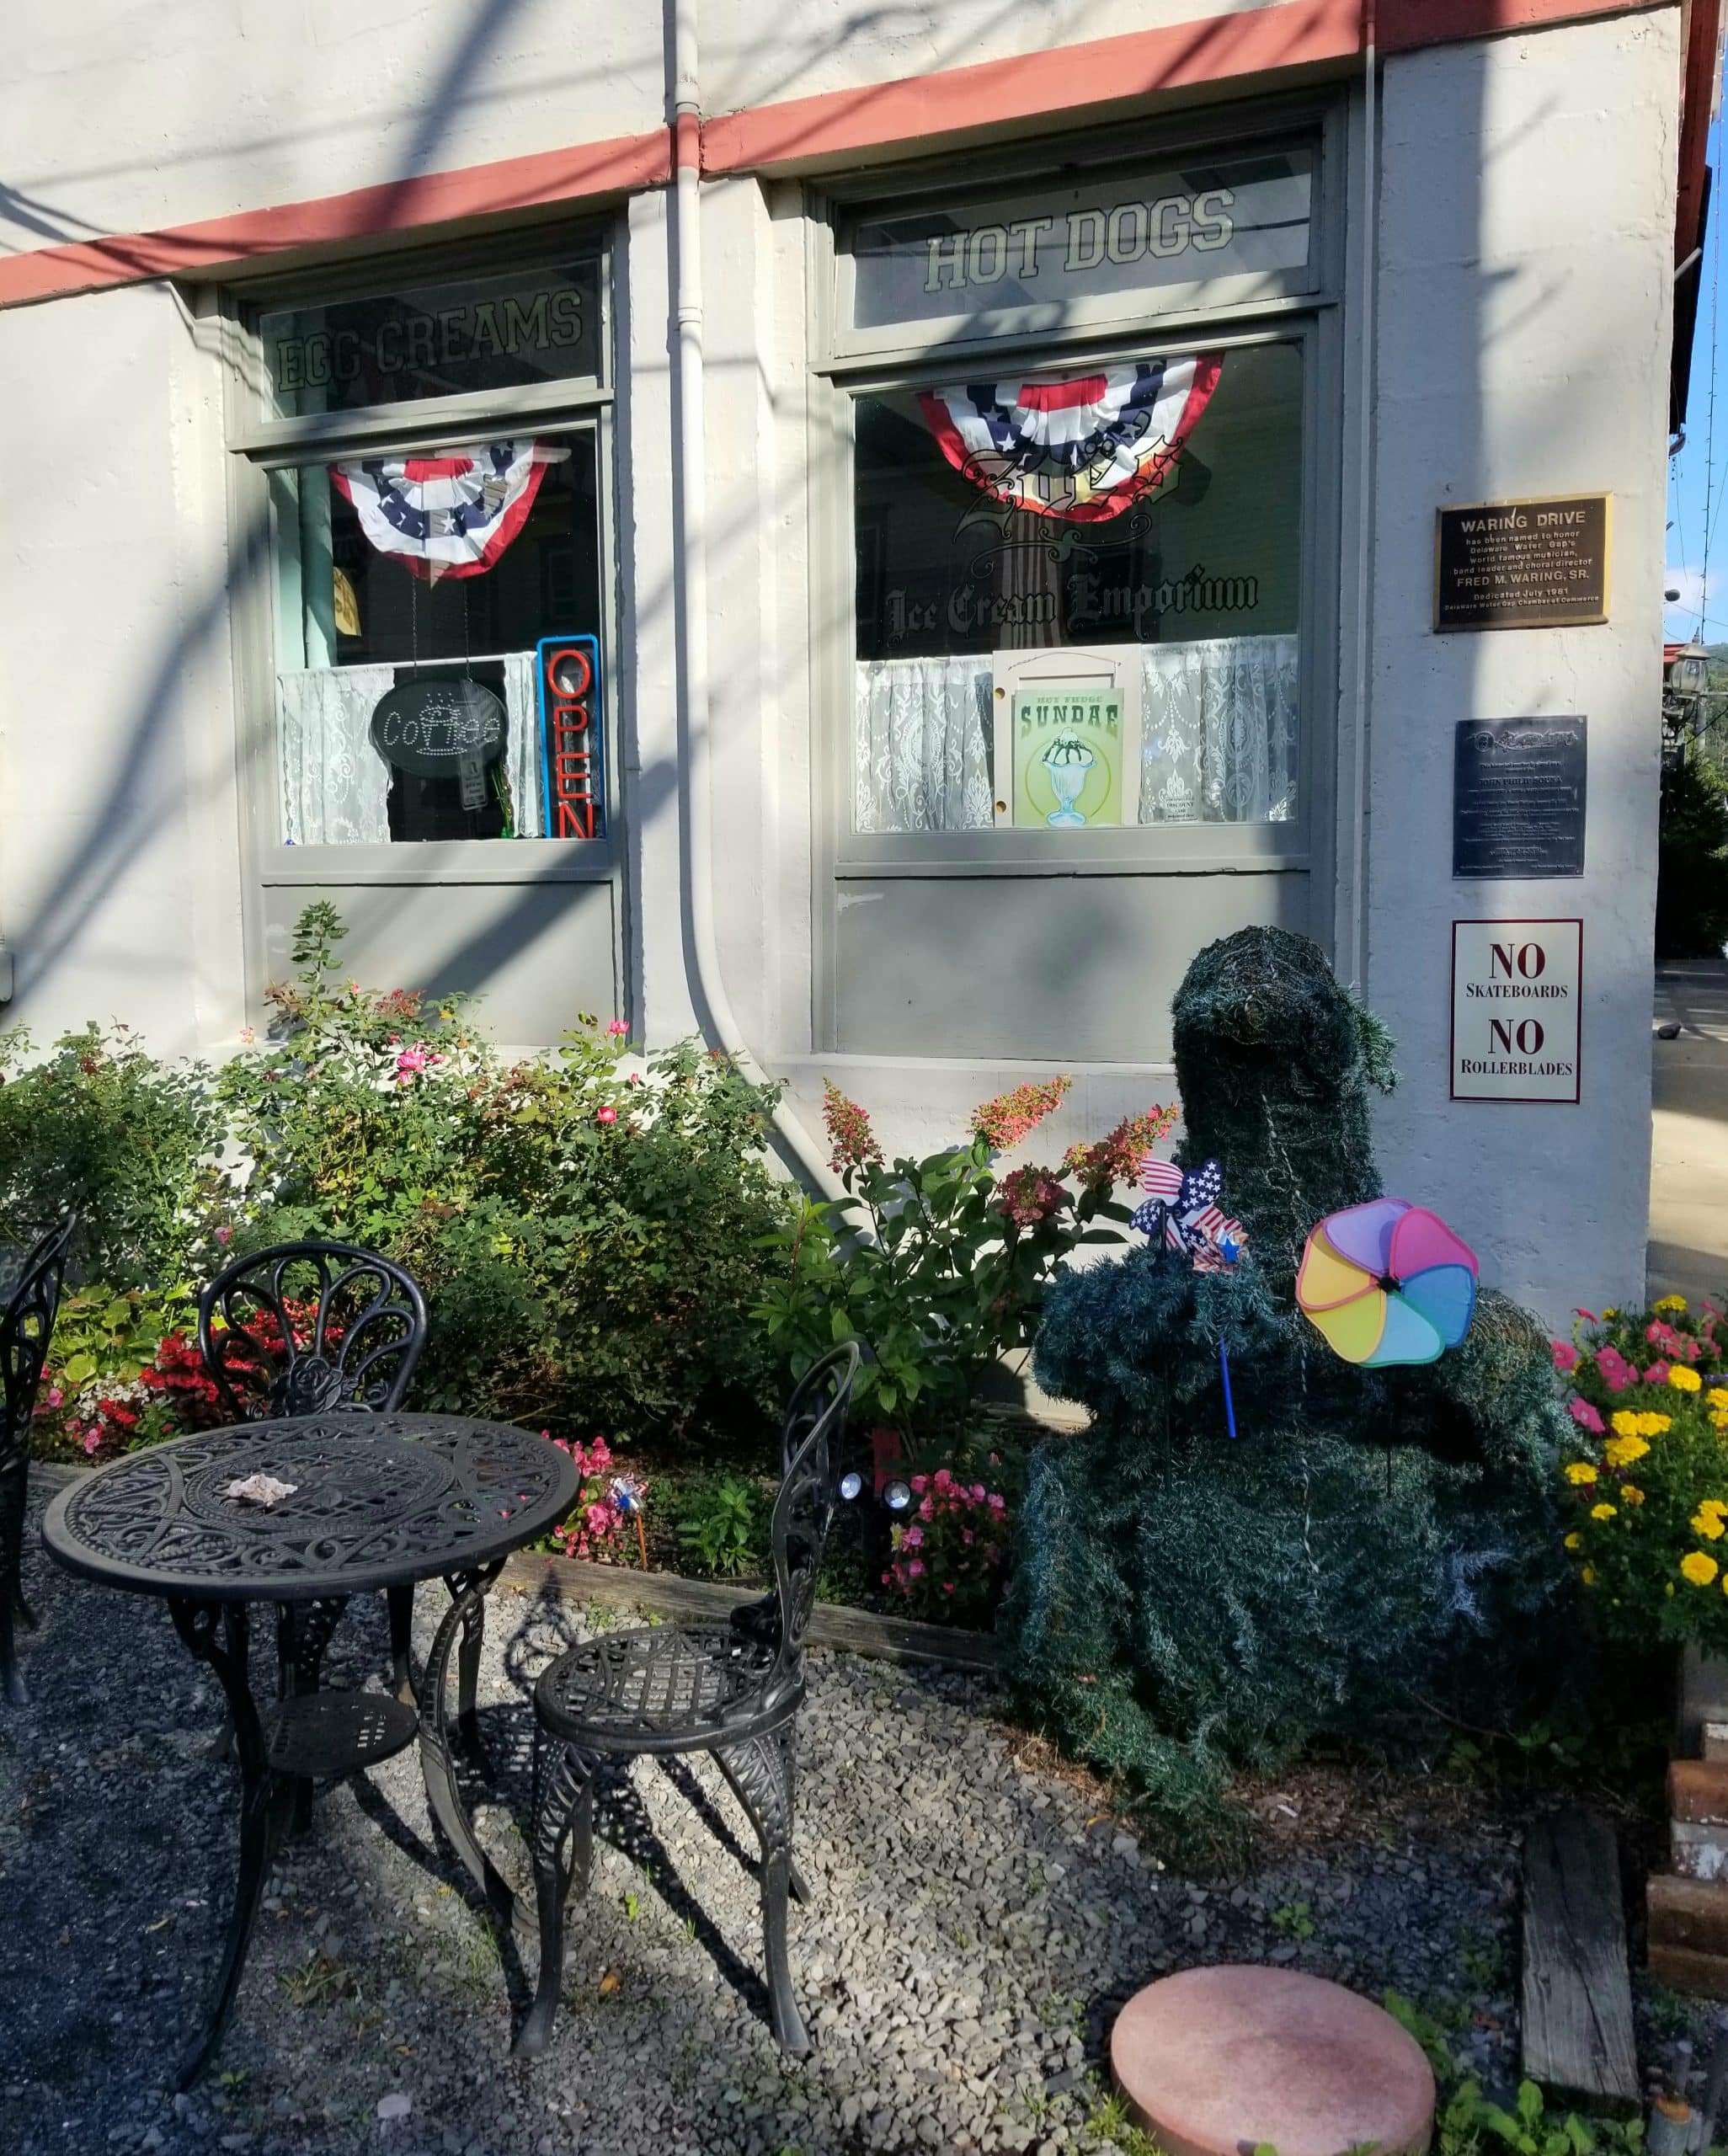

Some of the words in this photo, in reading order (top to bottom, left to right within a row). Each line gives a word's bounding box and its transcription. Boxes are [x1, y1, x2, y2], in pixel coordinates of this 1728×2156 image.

[924, 216, 1053, 293] HOT
[1064, 188, 1235, 272] DOGS
[276, 332, 361, 392] EGG
[376, 288, 583, 375] CREAMS
[1461, 515, 1528, 533] WARING
[1537, 511, 1586, 526] DRIVE
[1485, 536, 1507, 544] been
[1508, 533, 1539, 542] named
[1554, 531, 1580, 539] honor
[1469, 555, 1496, 563] world
[1499, 552, 1531, 562] famous
[1533, 550, 1577, 559] musician,
[1470, 546, 1508, 555] Delaware
[1515, 542, 1542, 552] Water
[1549, 540, 1576, 549] Gap's
[1453, 566, 1475, 575] band
[1478, 563, 1505, 574] leader
[1507, 562, 1523, 571] and
[1525, 561, 1554, 570] choral
[1555, 558, 1592, 568] director
[1457, 576, 1490, 588] FRED
[1495, 574, 1507, 585] M.
[1511, 571, 1566, 583] WARING,
[1569, 569, 1590, 579] SR.
[1474, 590, 1520, 600] Dedicated
[1523, 589, 1543, 598] July
[1546, 588, 1568, 596] 1981
[1480, 601, 1500, 610] Water
[1517, 598, 1550, 606] Chamber
[1551, 596, 1559, 605] of
[1561, 595, 1600, 604] Commerce
[885, 585, 938, 647] Ice
[947, 583, 1057, 639] Cream
[1065, 563, 1259, 642] Emporium
[1021, 704, 1118, 739] SUNDAE
[547, 649, 594, 839] OPEN
[1489, 942, 1546, 979] NO
[1466, 983, 1568, 998] SKATEBOARDS
[1488, 1018, 1544, 1054] NO
[1461, 1059, 1573, 1076] ROLLERBLADES
